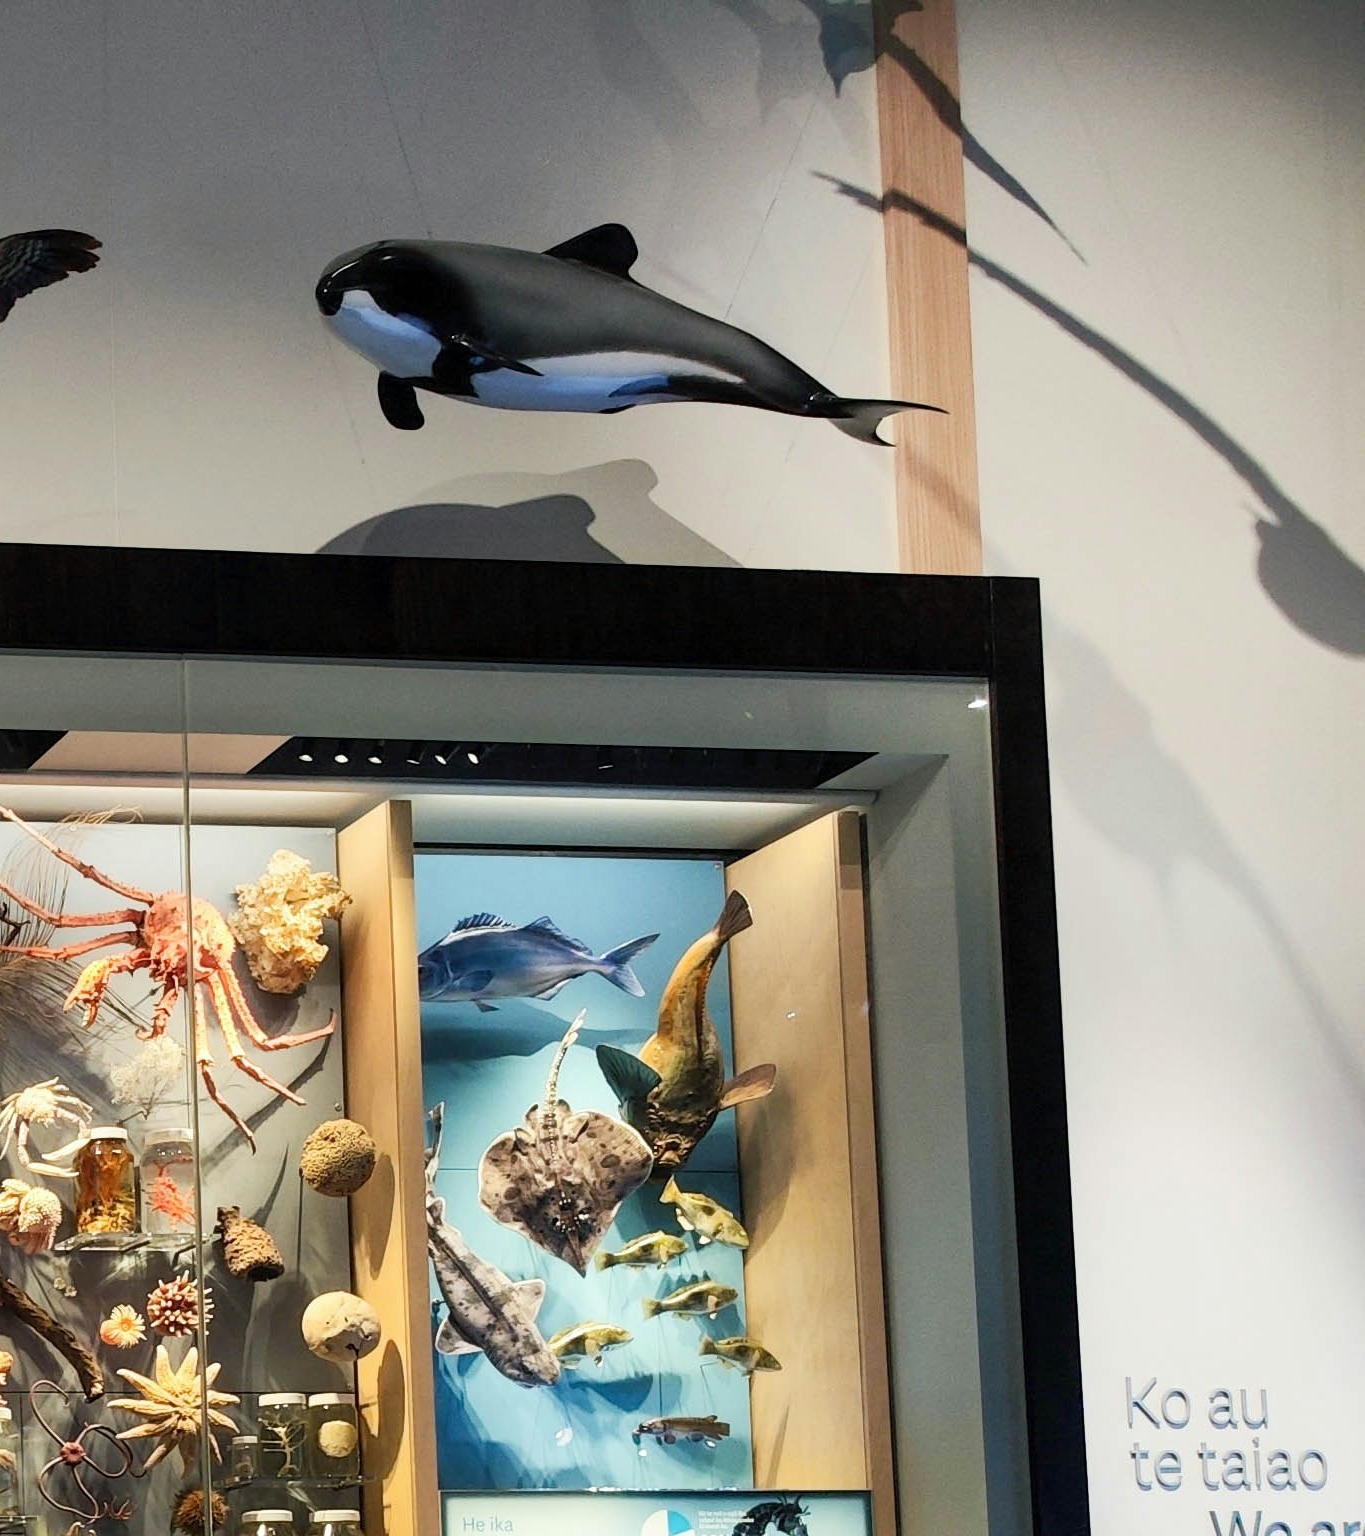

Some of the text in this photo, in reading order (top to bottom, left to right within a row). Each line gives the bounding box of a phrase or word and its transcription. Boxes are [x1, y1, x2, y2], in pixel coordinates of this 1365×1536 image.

[1125, 1376, 1268, 1429] Ko au
[1130, 1436, 1327, 1491] te taiao
[462, 1515, 514, 1532] He ika
